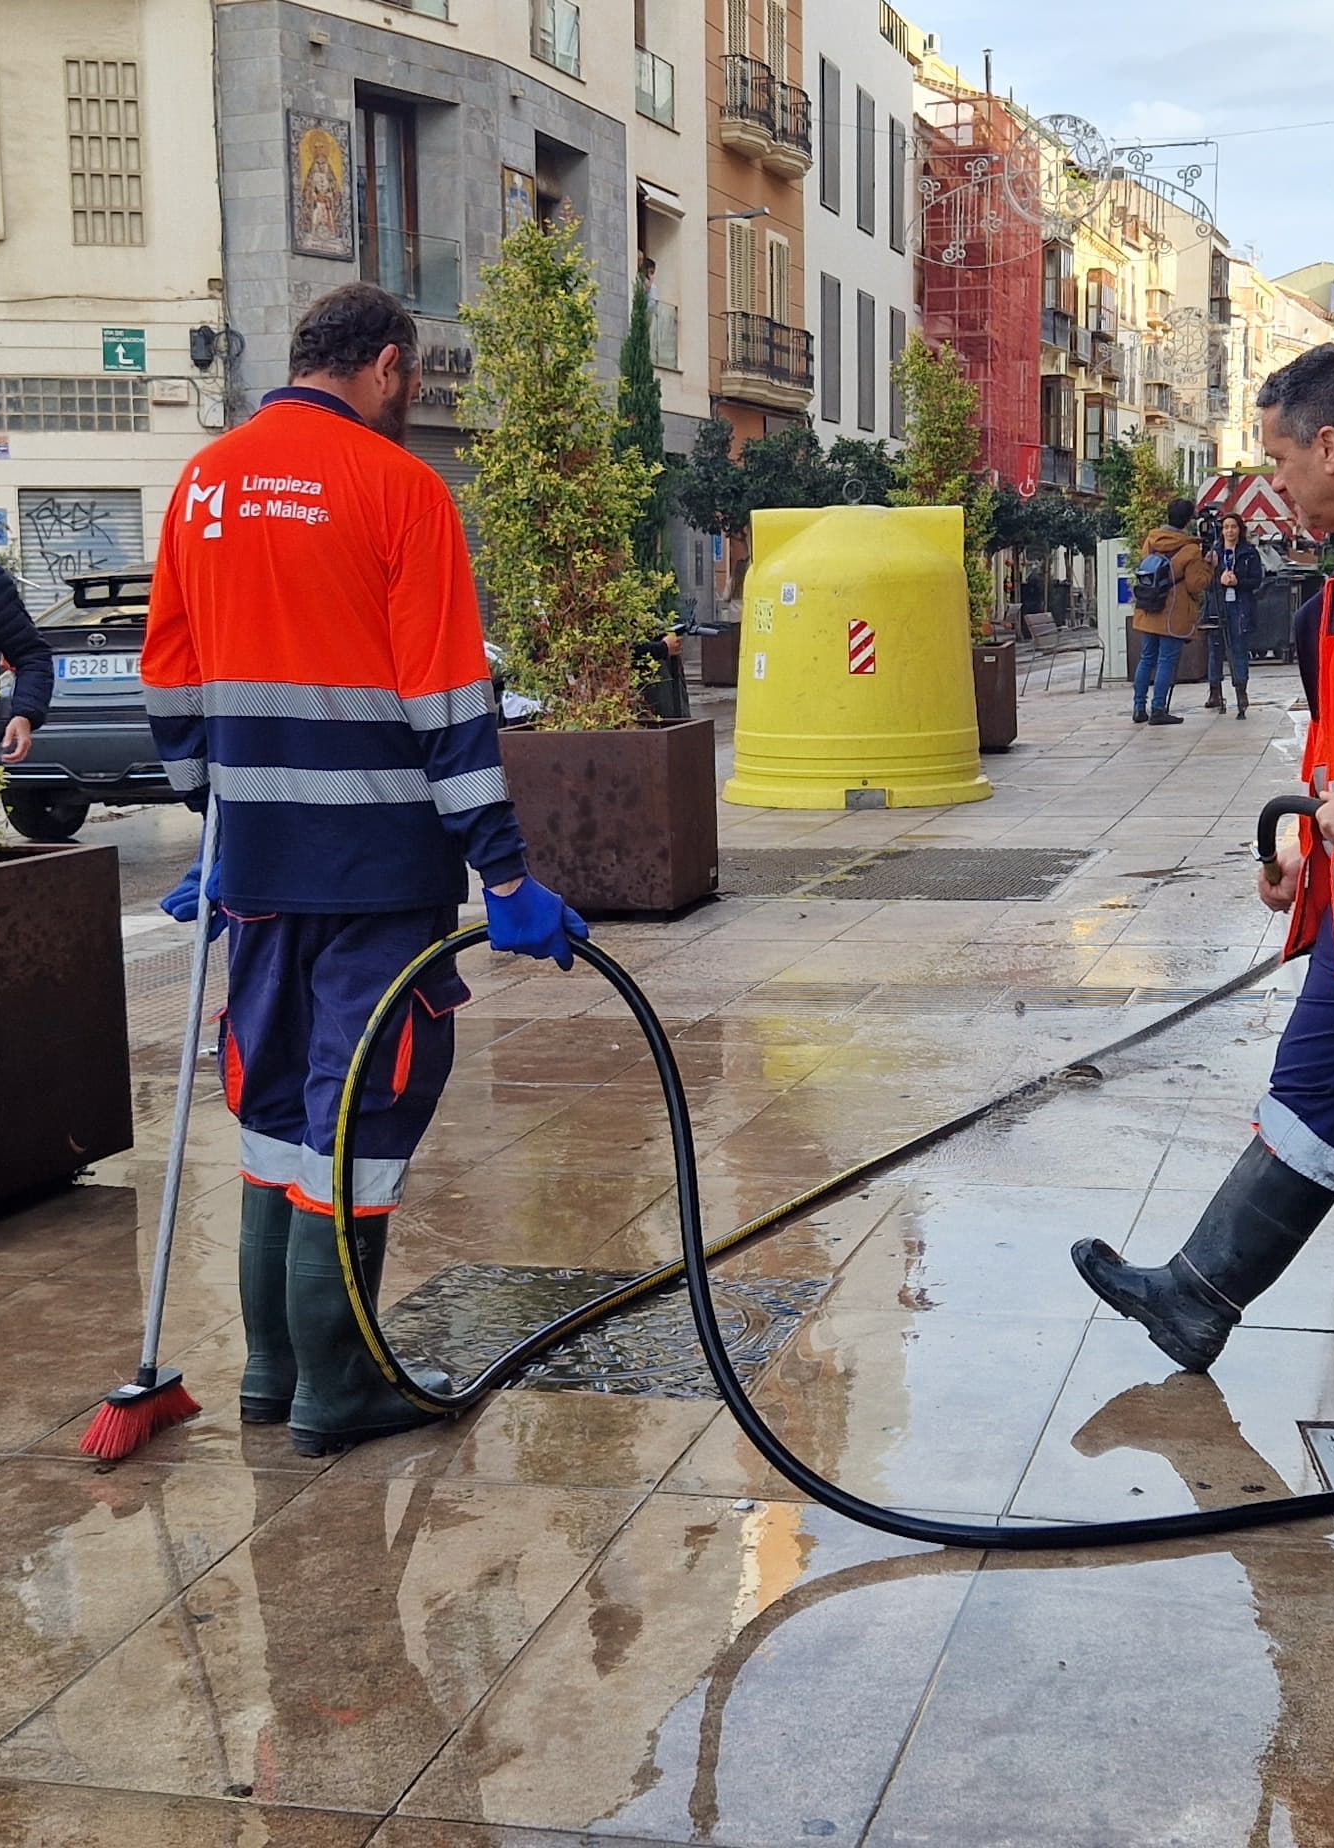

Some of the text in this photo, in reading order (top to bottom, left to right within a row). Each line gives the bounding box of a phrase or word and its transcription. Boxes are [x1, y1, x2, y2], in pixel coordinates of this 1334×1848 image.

[241, 475, 323, 495] Limpieza
[239, 499, 331, 525] de Málaga
[69, 659, 109, 676] 6328
